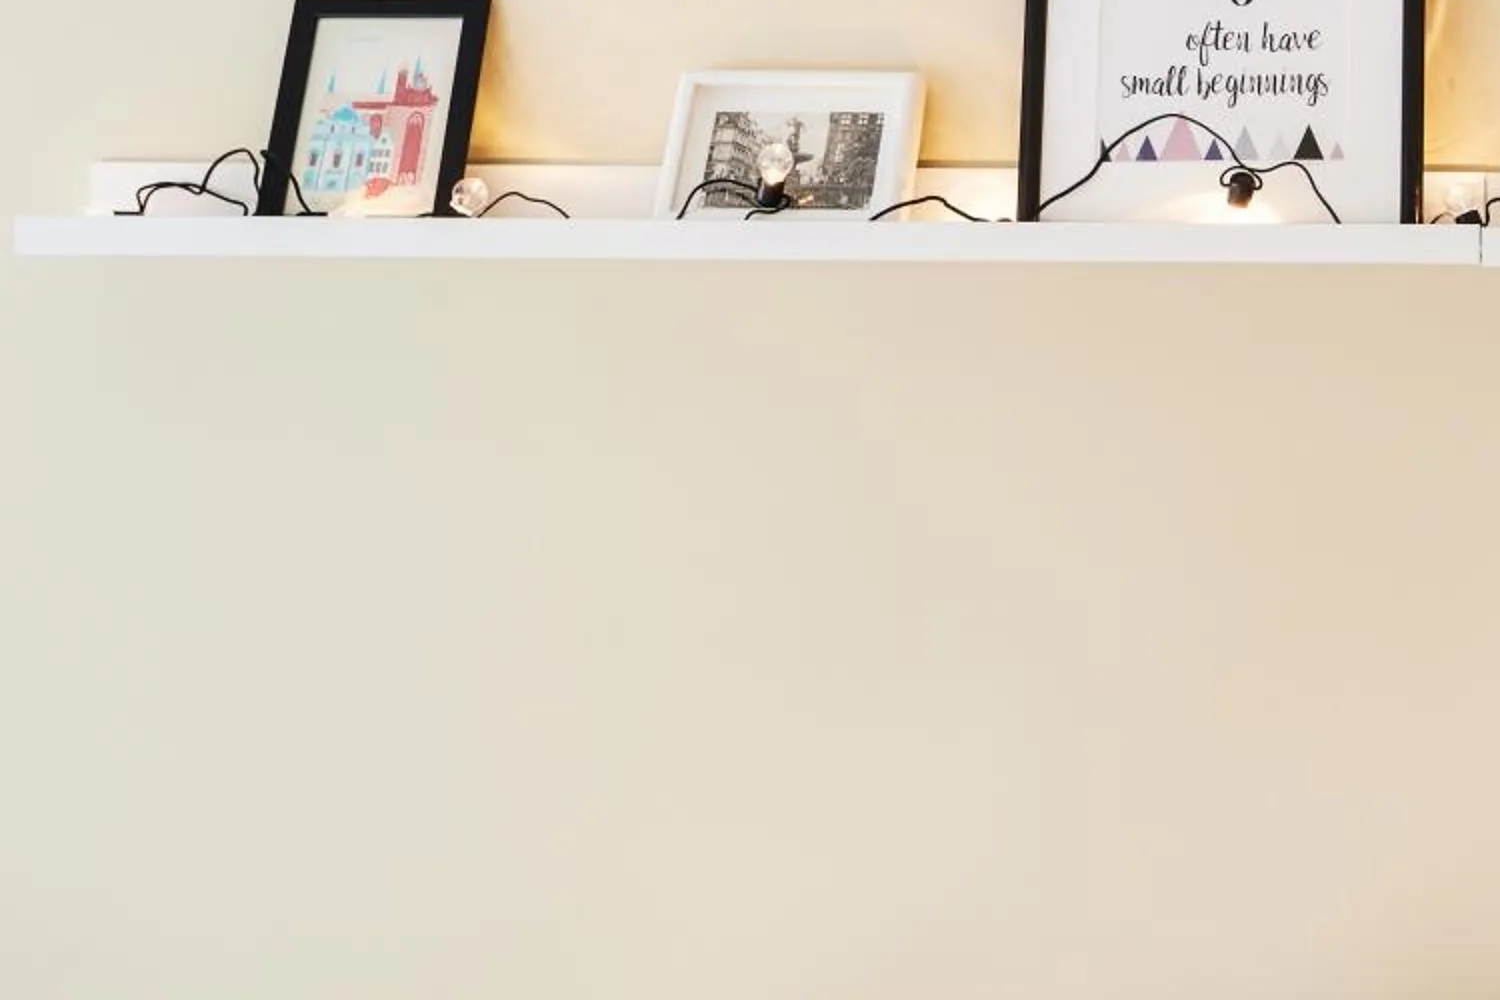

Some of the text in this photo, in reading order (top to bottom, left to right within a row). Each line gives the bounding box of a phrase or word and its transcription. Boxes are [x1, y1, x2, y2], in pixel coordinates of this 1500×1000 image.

[1185, 20, 1321, 67] often have
[1120, 65, 1329, 108] small beginnings
